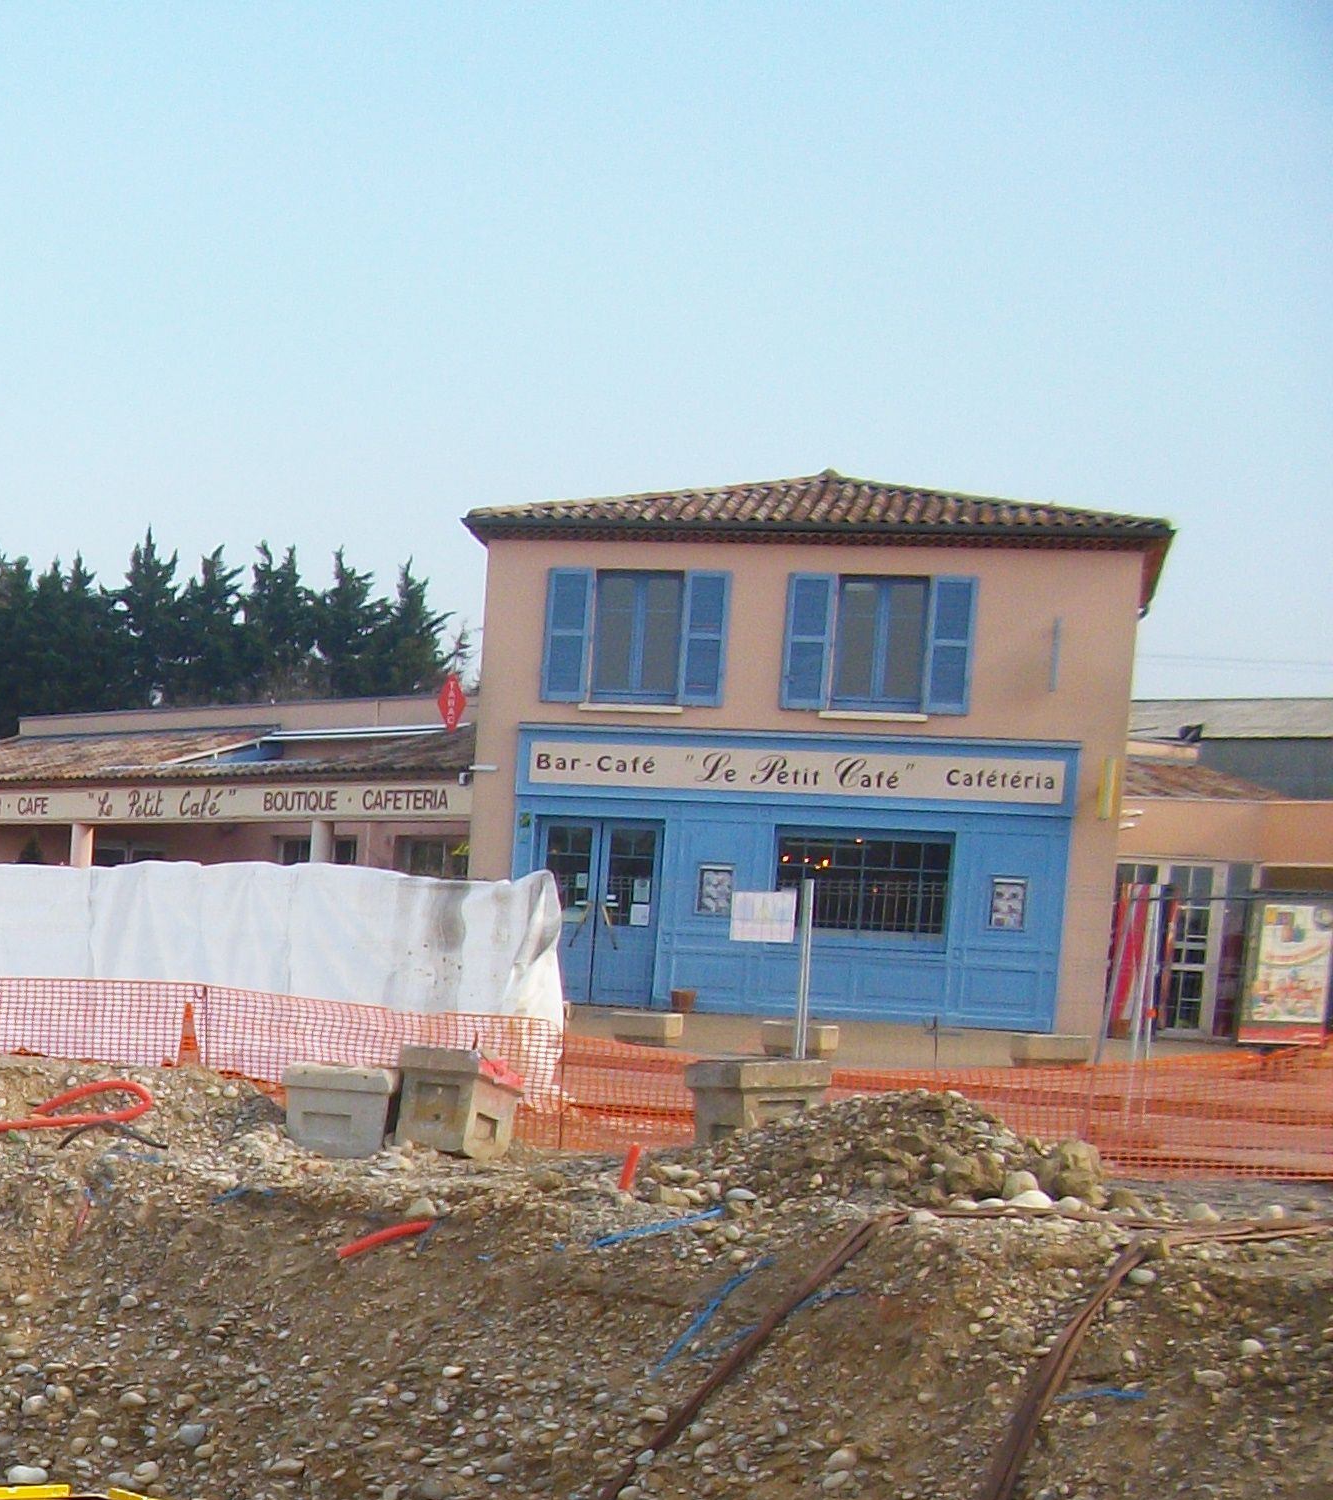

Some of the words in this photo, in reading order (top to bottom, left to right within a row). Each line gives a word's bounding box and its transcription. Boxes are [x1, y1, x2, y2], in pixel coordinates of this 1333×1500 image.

[536, 753, 656, 774] Bar-Café
[750, 754, 819, 785] Petit
[946, 769, 1055, 790] Cafétéria
[128, 789, 164, 818] Petit
[263, 790, 338, 812] BOUTIQUE
[362, 789, 448, 810] CAFETERIA
